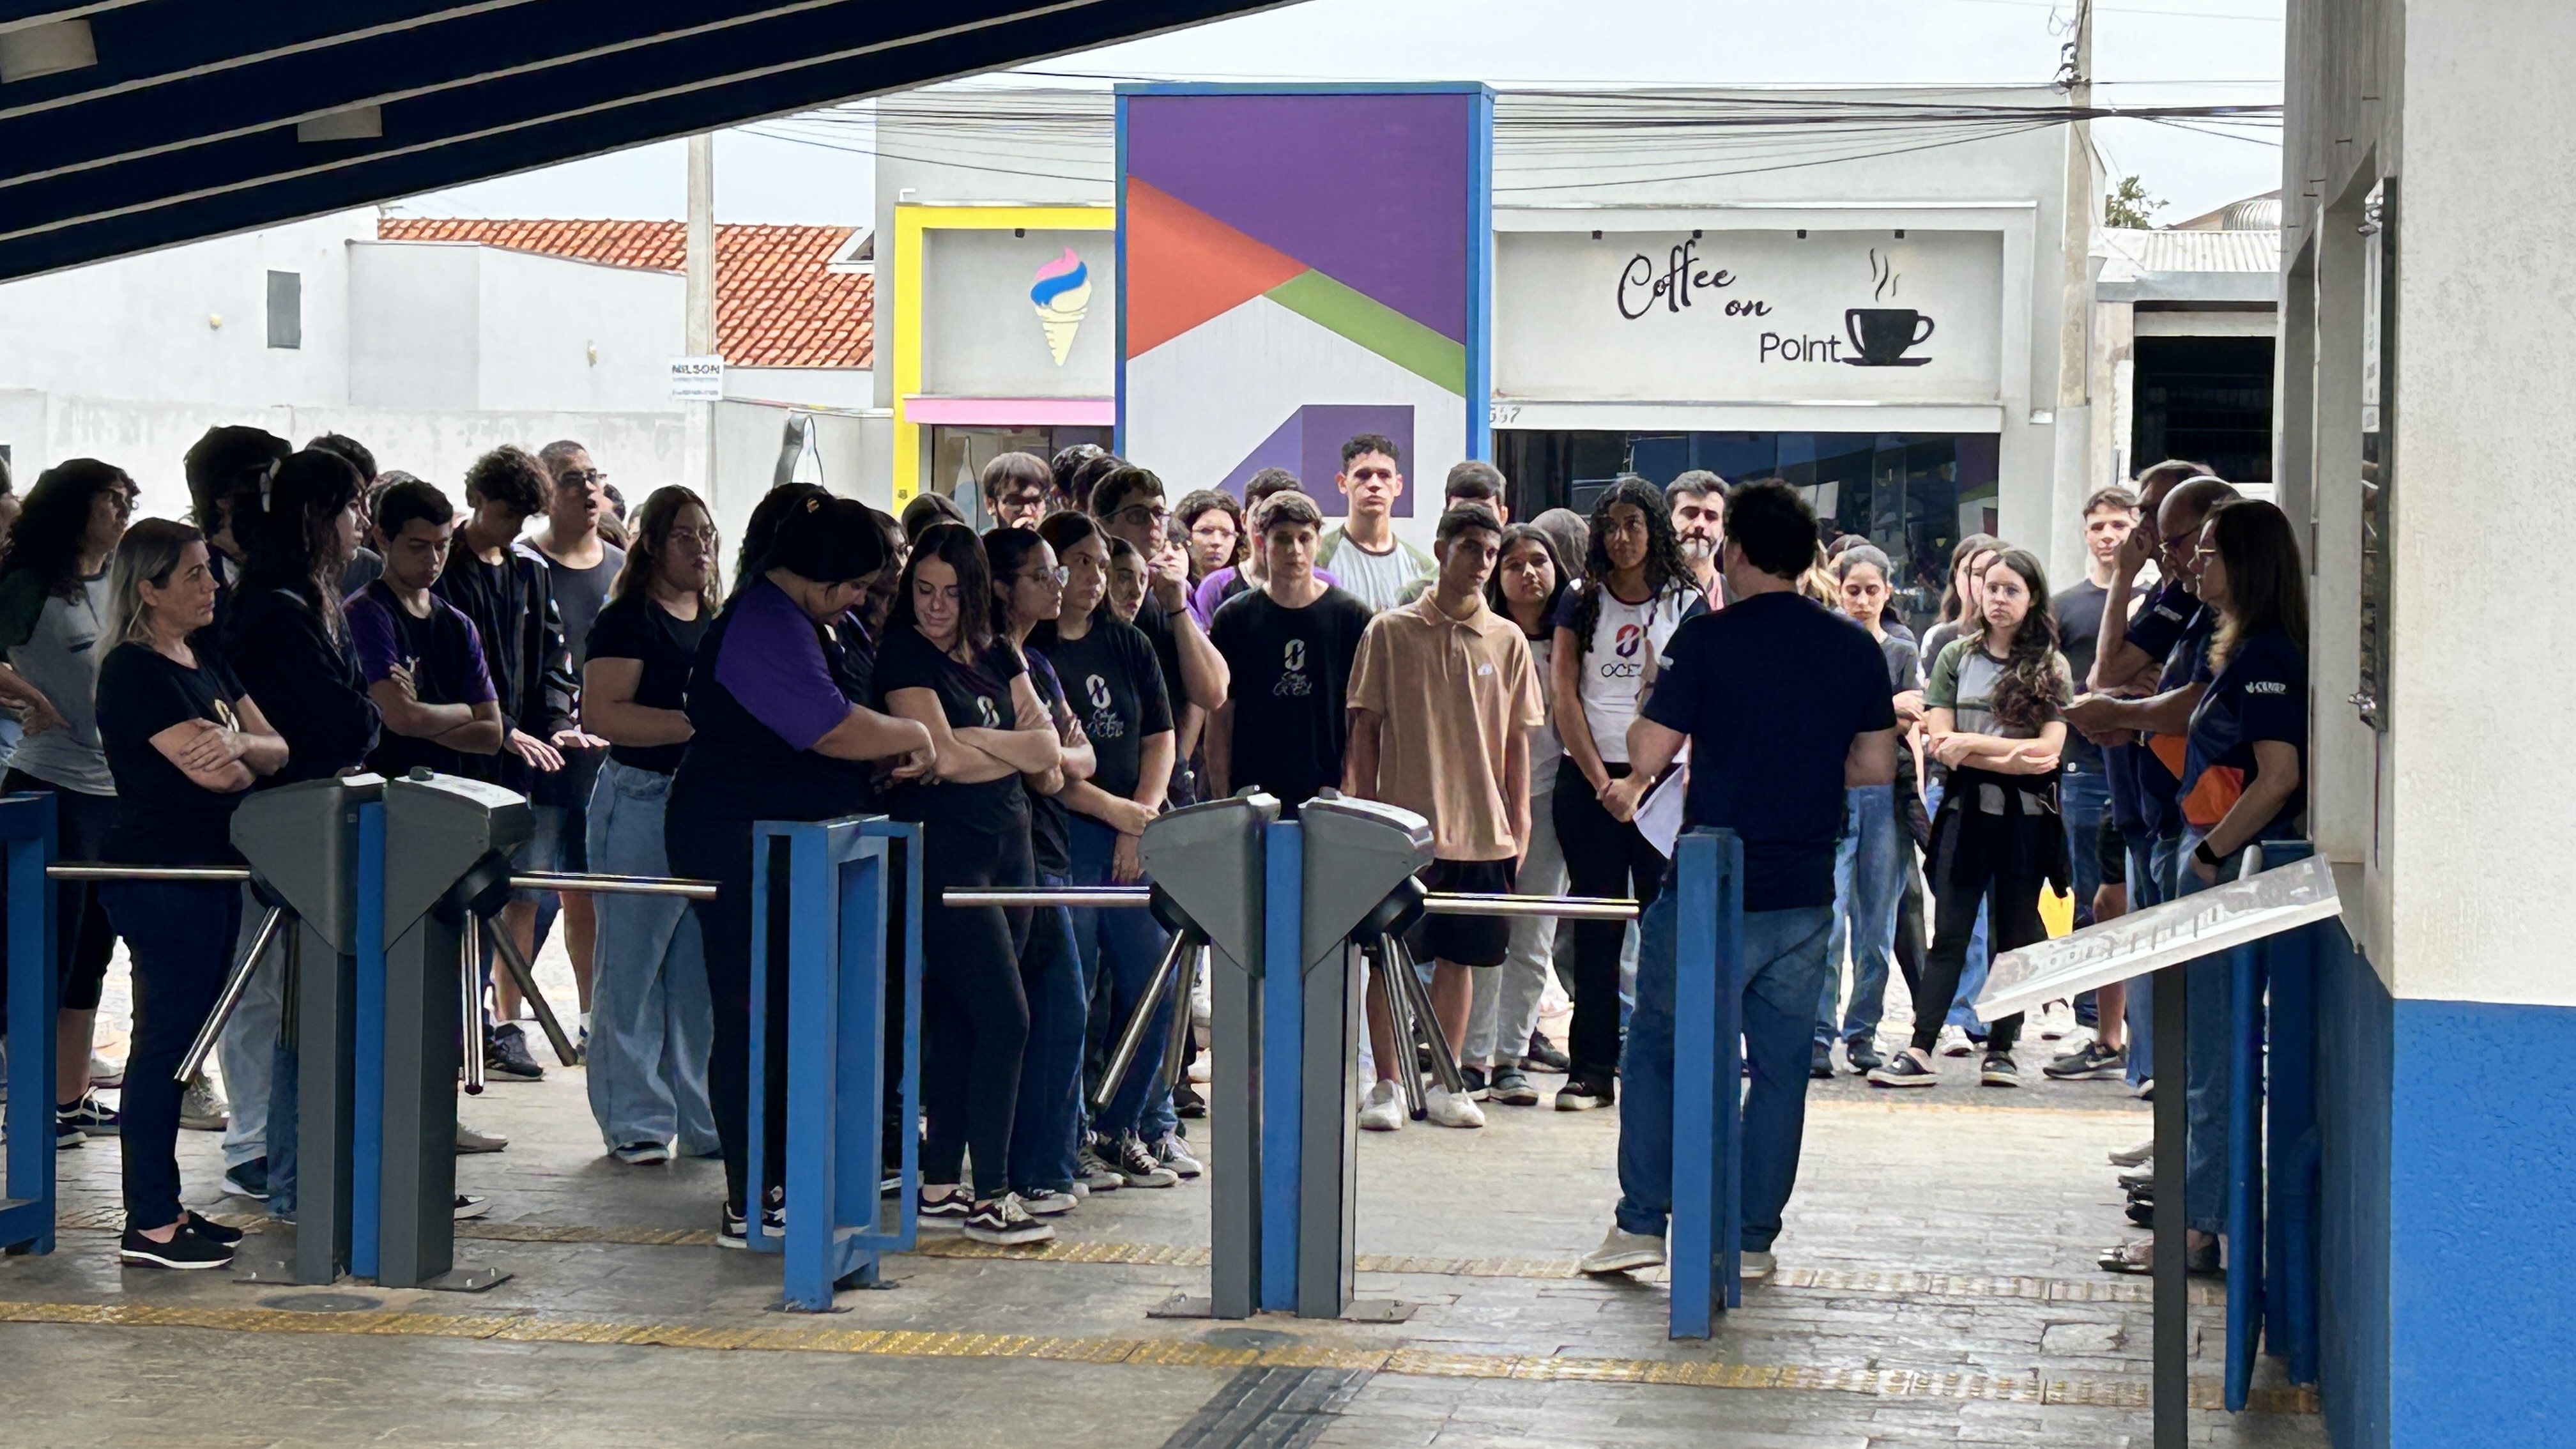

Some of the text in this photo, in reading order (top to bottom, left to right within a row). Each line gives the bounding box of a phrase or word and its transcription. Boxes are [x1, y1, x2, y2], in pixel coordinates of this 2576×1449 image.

[1617, 239, 1736, 320] Coffee
[1724, 300, 1773, 317] on
[1760, 332, 1841, 363] Point
[671, 364, 720, 374] NILSON
